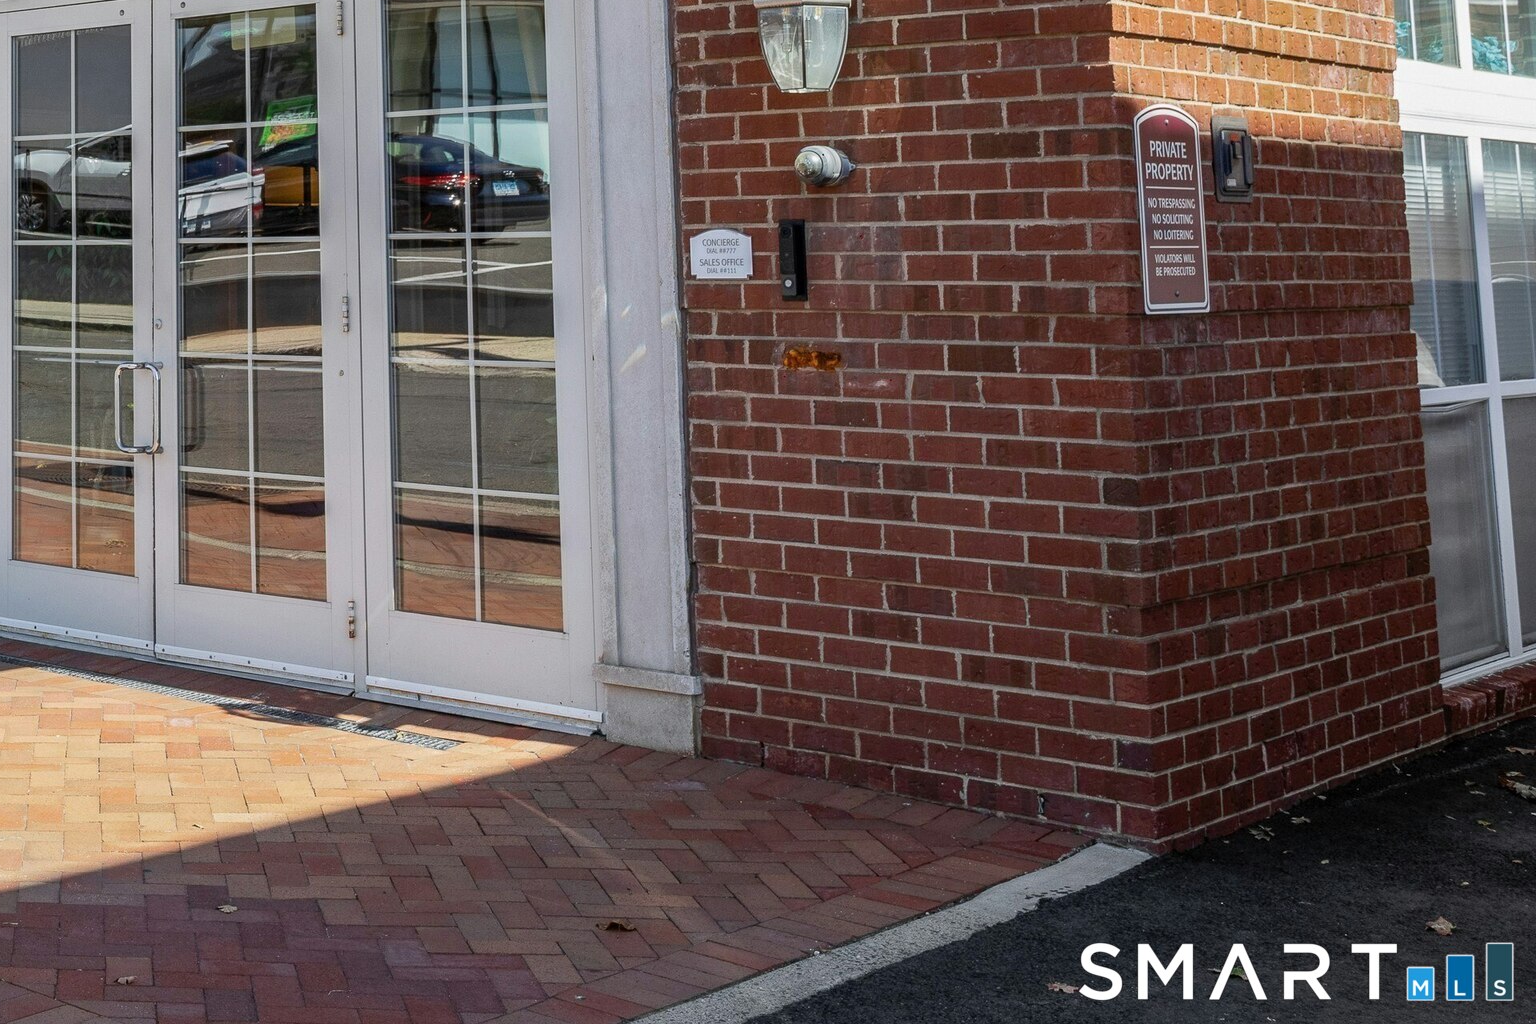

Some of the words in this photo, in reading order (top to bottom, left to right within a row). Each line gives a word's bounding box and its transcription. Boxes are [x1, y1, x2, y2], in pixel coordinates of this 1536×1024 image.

[1149, 140, 1187, 158] PRIVATE
[1145, 162, 1194, 180] PROPERTY
[1147, 197, 1157, 208] NO
[1158, 197, 1195, 209] TRESPASSING
[1152, 213, 1162, 224] NO
[1162, 213, 1193, 224] SOLICITING
[1154, 229, 1163, 240] NO
[1164, 229, 1194, 240] LOITERING
[702, 238, 740, 246] CONCIERGE
[699, 258, 720, 267] SALES
[721, 258, 744, 266] OFFICE
[1154, 253, 1182, 264] VIOLATORS
[1183, 253, 1196, 263] WILL
[1156, 266, 1162, 276] BE
[1164, 266, 1196, 276] PROSECUTED
